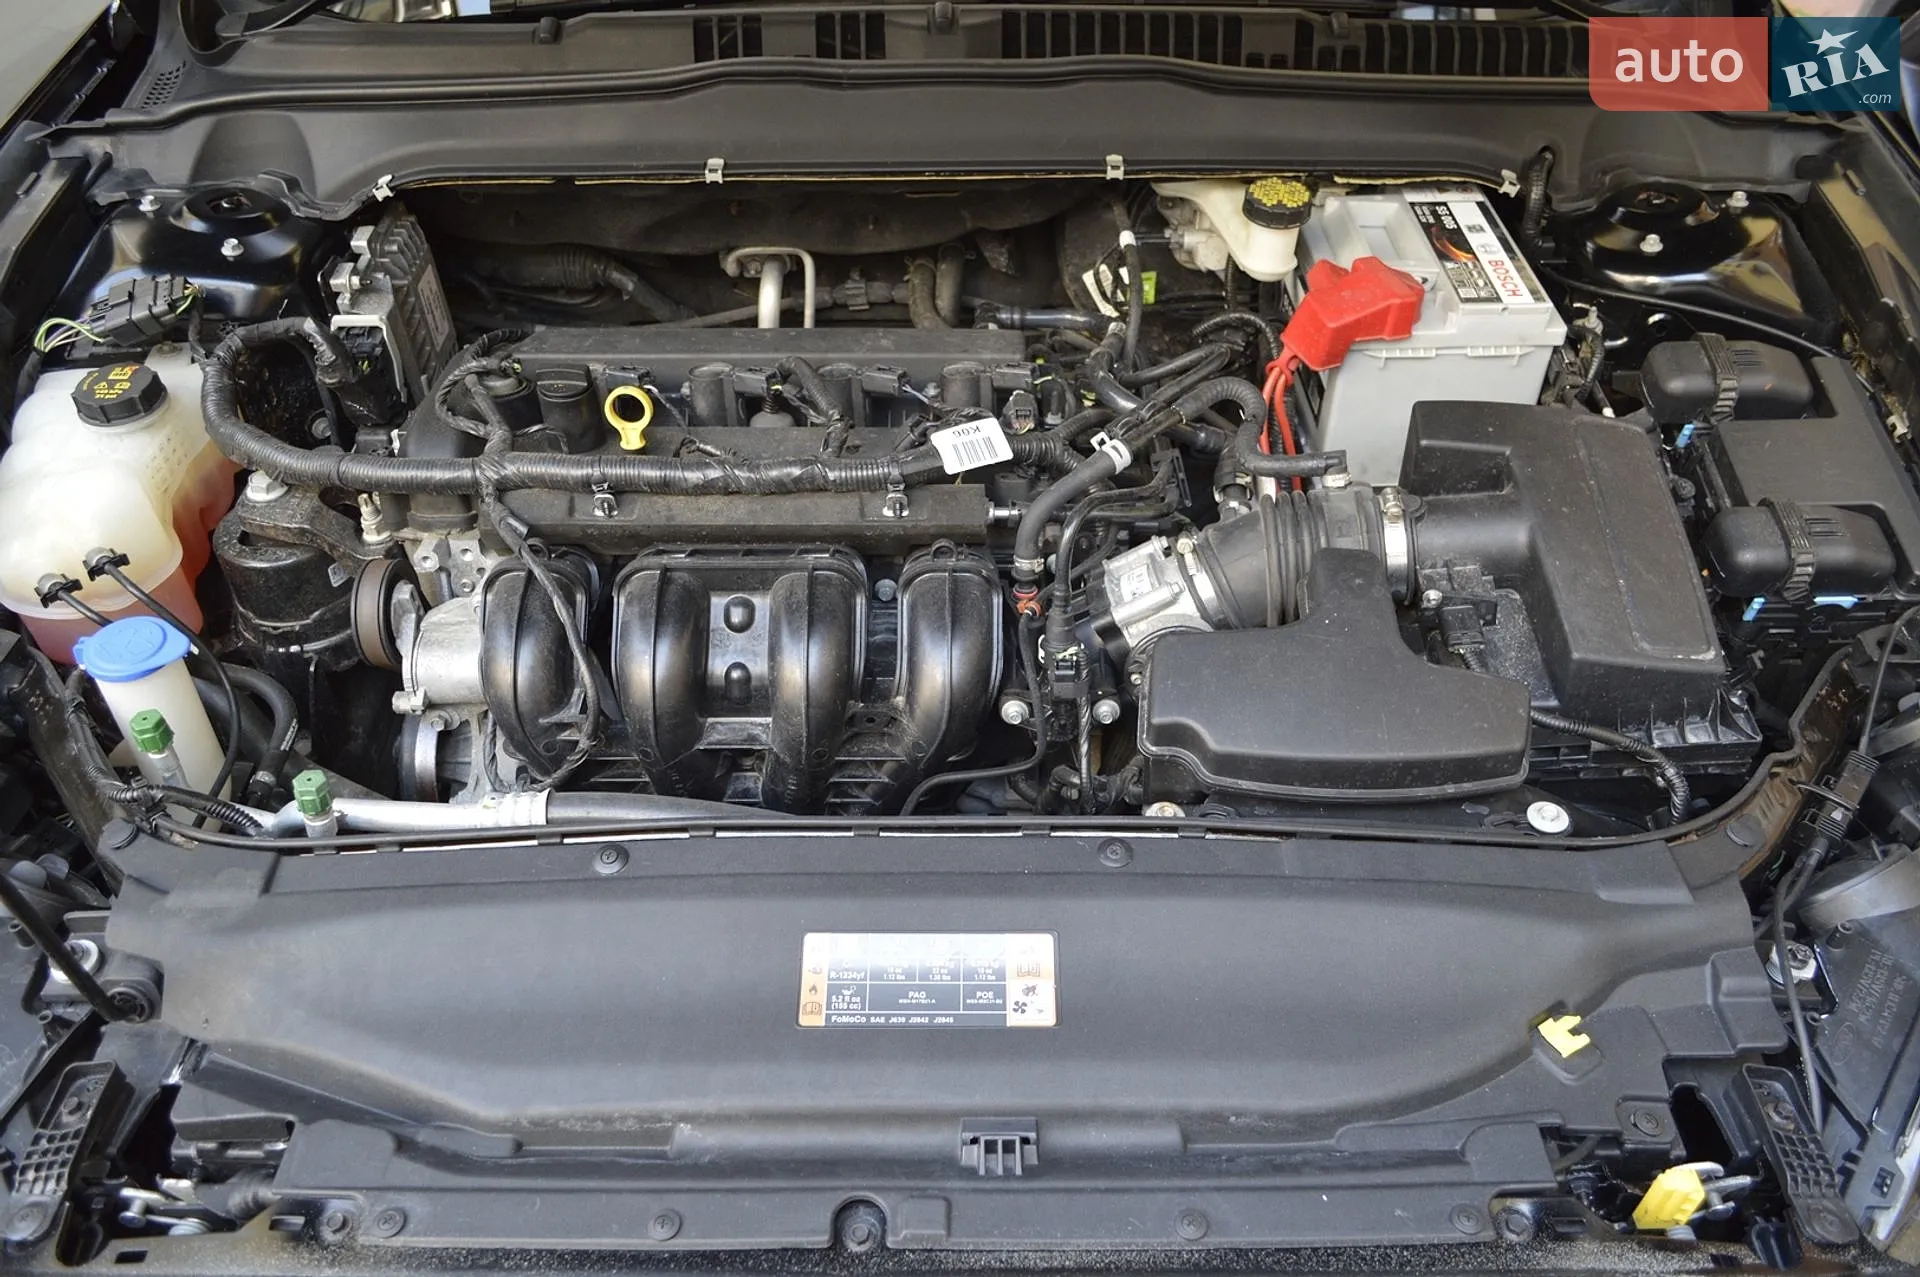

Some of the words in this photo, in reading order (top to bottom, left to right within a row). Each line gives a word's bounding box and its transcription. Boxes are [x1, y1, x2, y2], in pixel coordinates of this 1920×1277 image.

[1488, 259, 1523, 297] BOSCH
[976, 991, 994, 999] POE
[831, 1015, 866, 1023] FoMoCo
